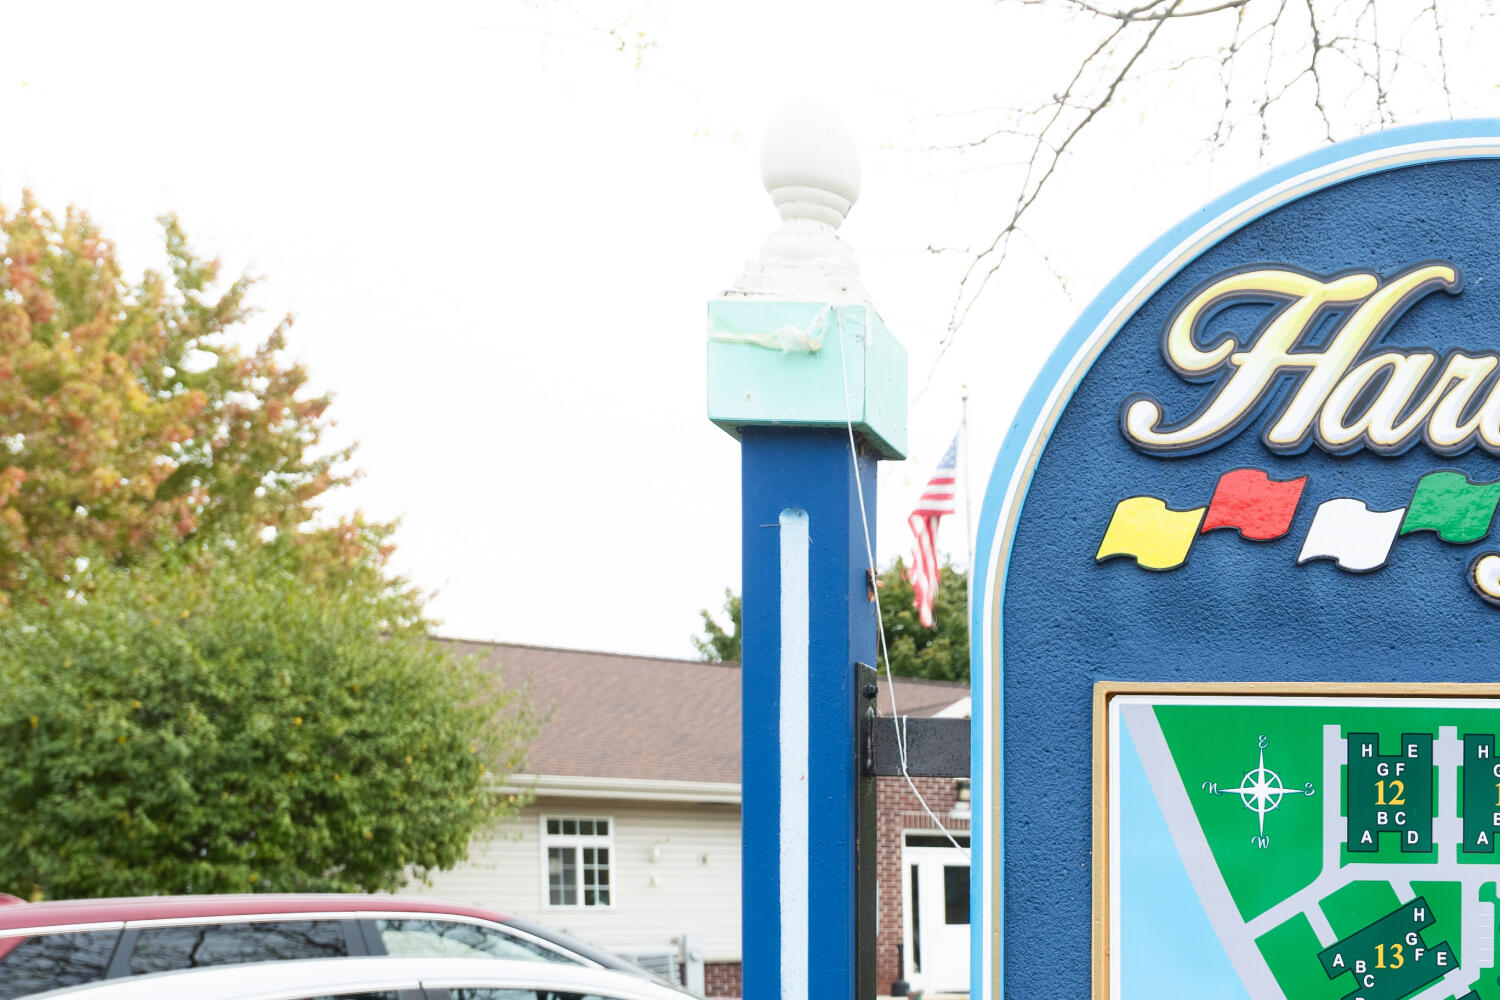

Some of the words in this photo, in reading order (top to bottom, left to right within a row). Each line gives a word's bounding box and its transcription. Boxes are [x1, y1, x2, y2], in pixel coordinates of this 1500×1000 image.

[1361, 743, 1373, 758] H
[1407, 744, 1418, 758] E
[1478, 745, 1489, 759] H
[1376, 762, 1389, 777] G
[1396, 762, 1405, 777] F
[1304, 781, 1316, 797] S
[1375, 779, 1406, 806] 12
[1377, 811, 1389, 825] B
[1394, 811, 1406, 826] C
[1251, 835, 1271, 849] W
[1360, 830, 1373, 844] A
[1407, 830, 1419, 844] D
[1476, 831, 1489, 845] A
[1413, 907, 1425, 922] H
[1332, 953, 1345, 967] A
[1375, 943, 1405, 969] 13
[1437, 951, 1447, 966] E
